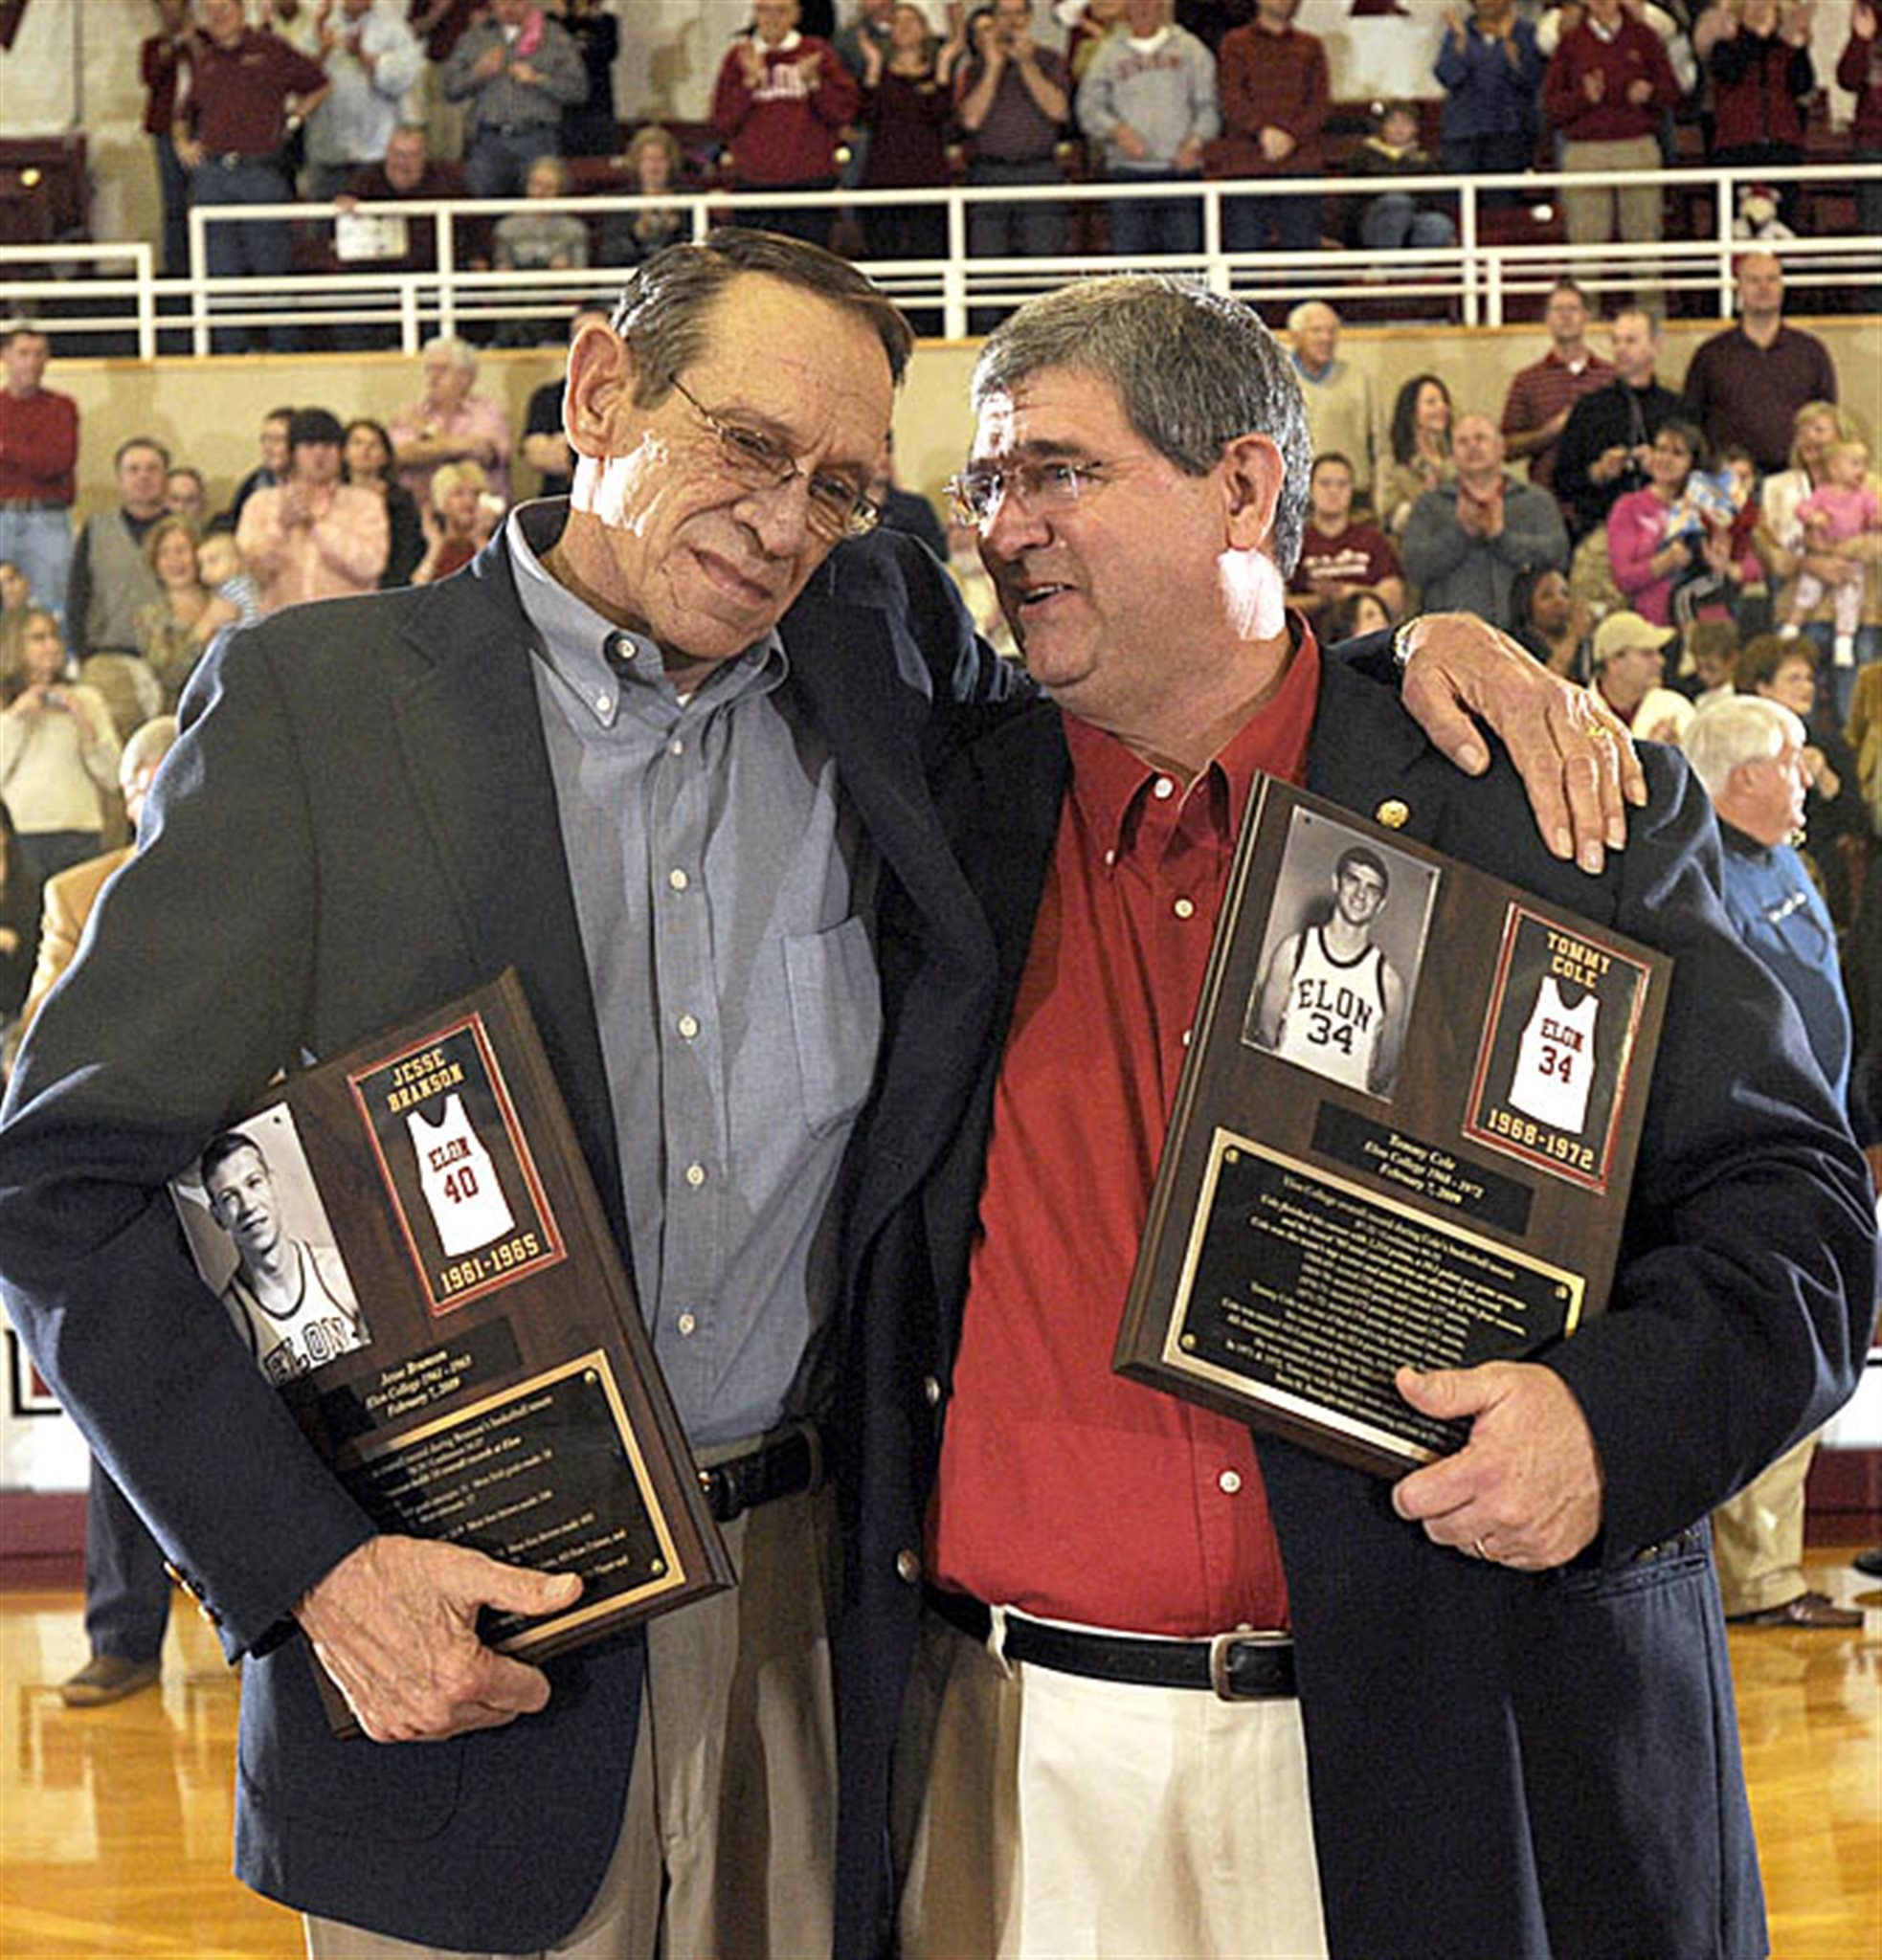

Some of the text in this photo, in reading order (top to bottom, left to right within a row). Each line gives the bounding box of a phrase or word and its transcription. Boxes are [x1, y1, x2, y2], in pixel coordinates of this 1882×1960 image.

[1547, 931, 1612, 975] TOMMY
[1552, 957, 1598, 989] COLE
[1298, 978, 1373, 1034] ELON
[1307, 1012, 1353, 1057] 34
[1540, 1017, 1585, 1054] ELON
[392, 1048, 446, 1087] JESSE
[1538, 1046, 1574, 1084] 34
[427, 1136, 473, 1173] ELON
[1487, 1108, 1596, 1170] 1968-1972
[1389, 1149, 1426, 1174] College
[1428, 1149, 1457, 1170] Cole
[443, 1165, 479, 1204] 40
[439, 1233, 540, 1294] 1961-1965
[263, 1317, 349, 1385] ELON
